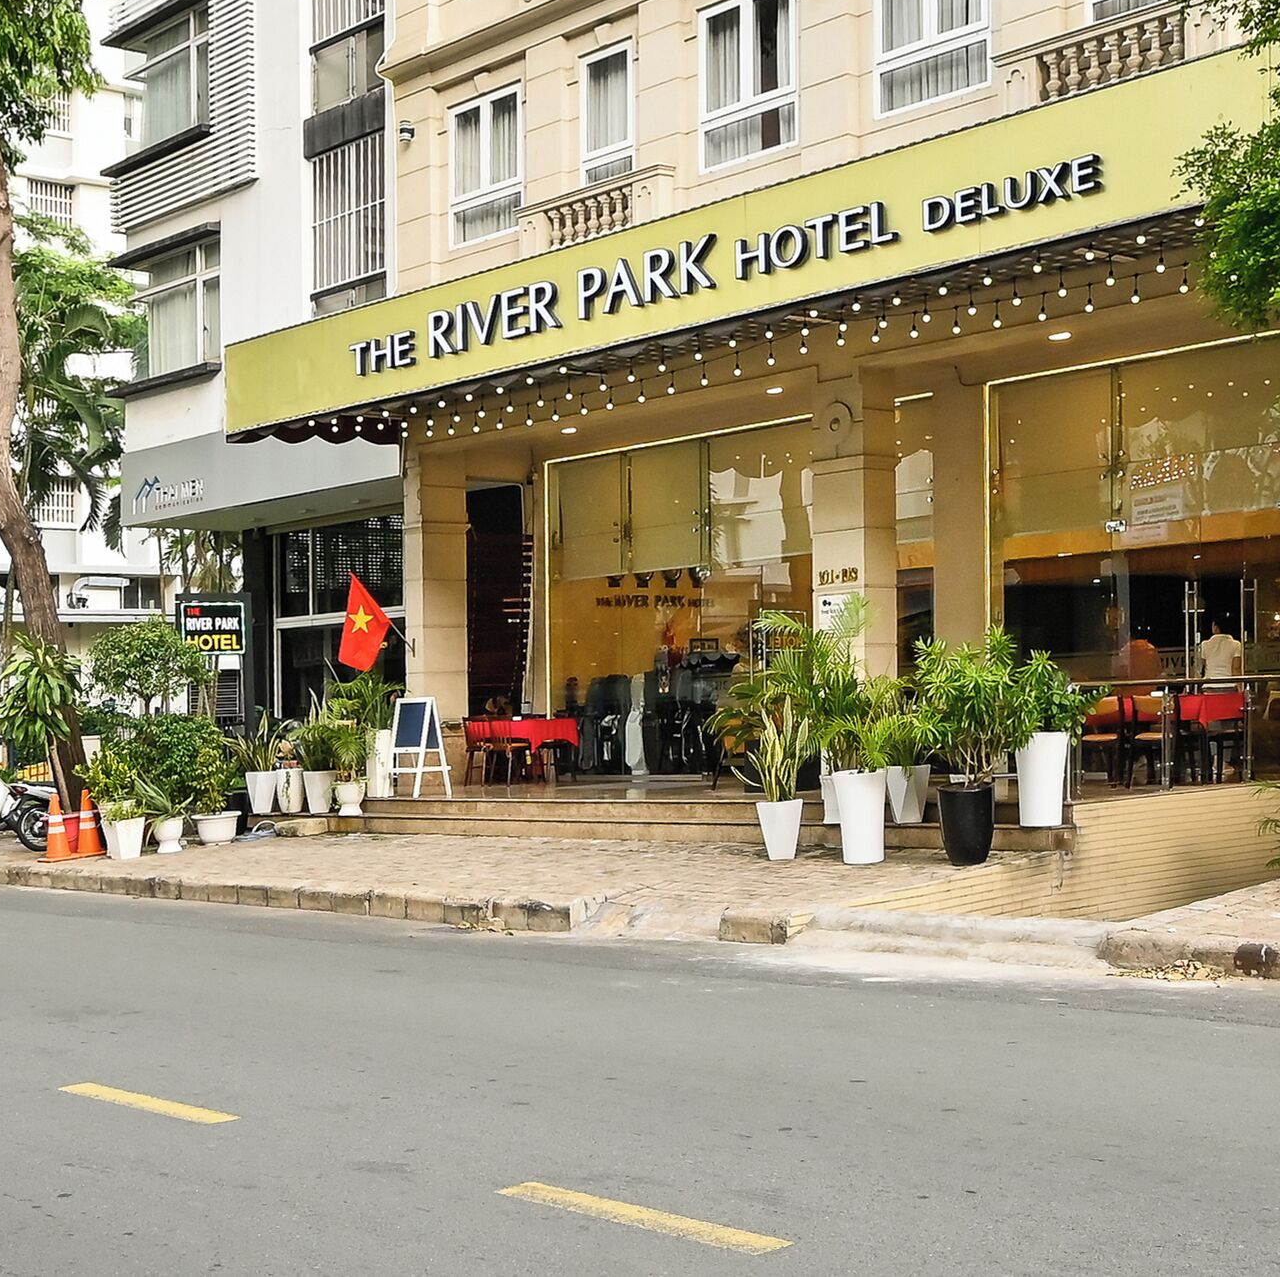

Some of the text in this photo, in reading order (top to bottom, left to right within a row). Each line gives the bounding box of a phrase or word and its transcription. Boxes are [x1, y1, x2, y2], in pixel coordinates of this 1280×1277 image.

[350, 153, 1104, 377] THE RIVER PARK HOTEL DELUXE
[654, 595, 686, 609] PARK
[186, 607, 202, 617] THE
[185, 617, 240, 631] RIVER PARK
[185, 634, 241, 651] HOTEL
